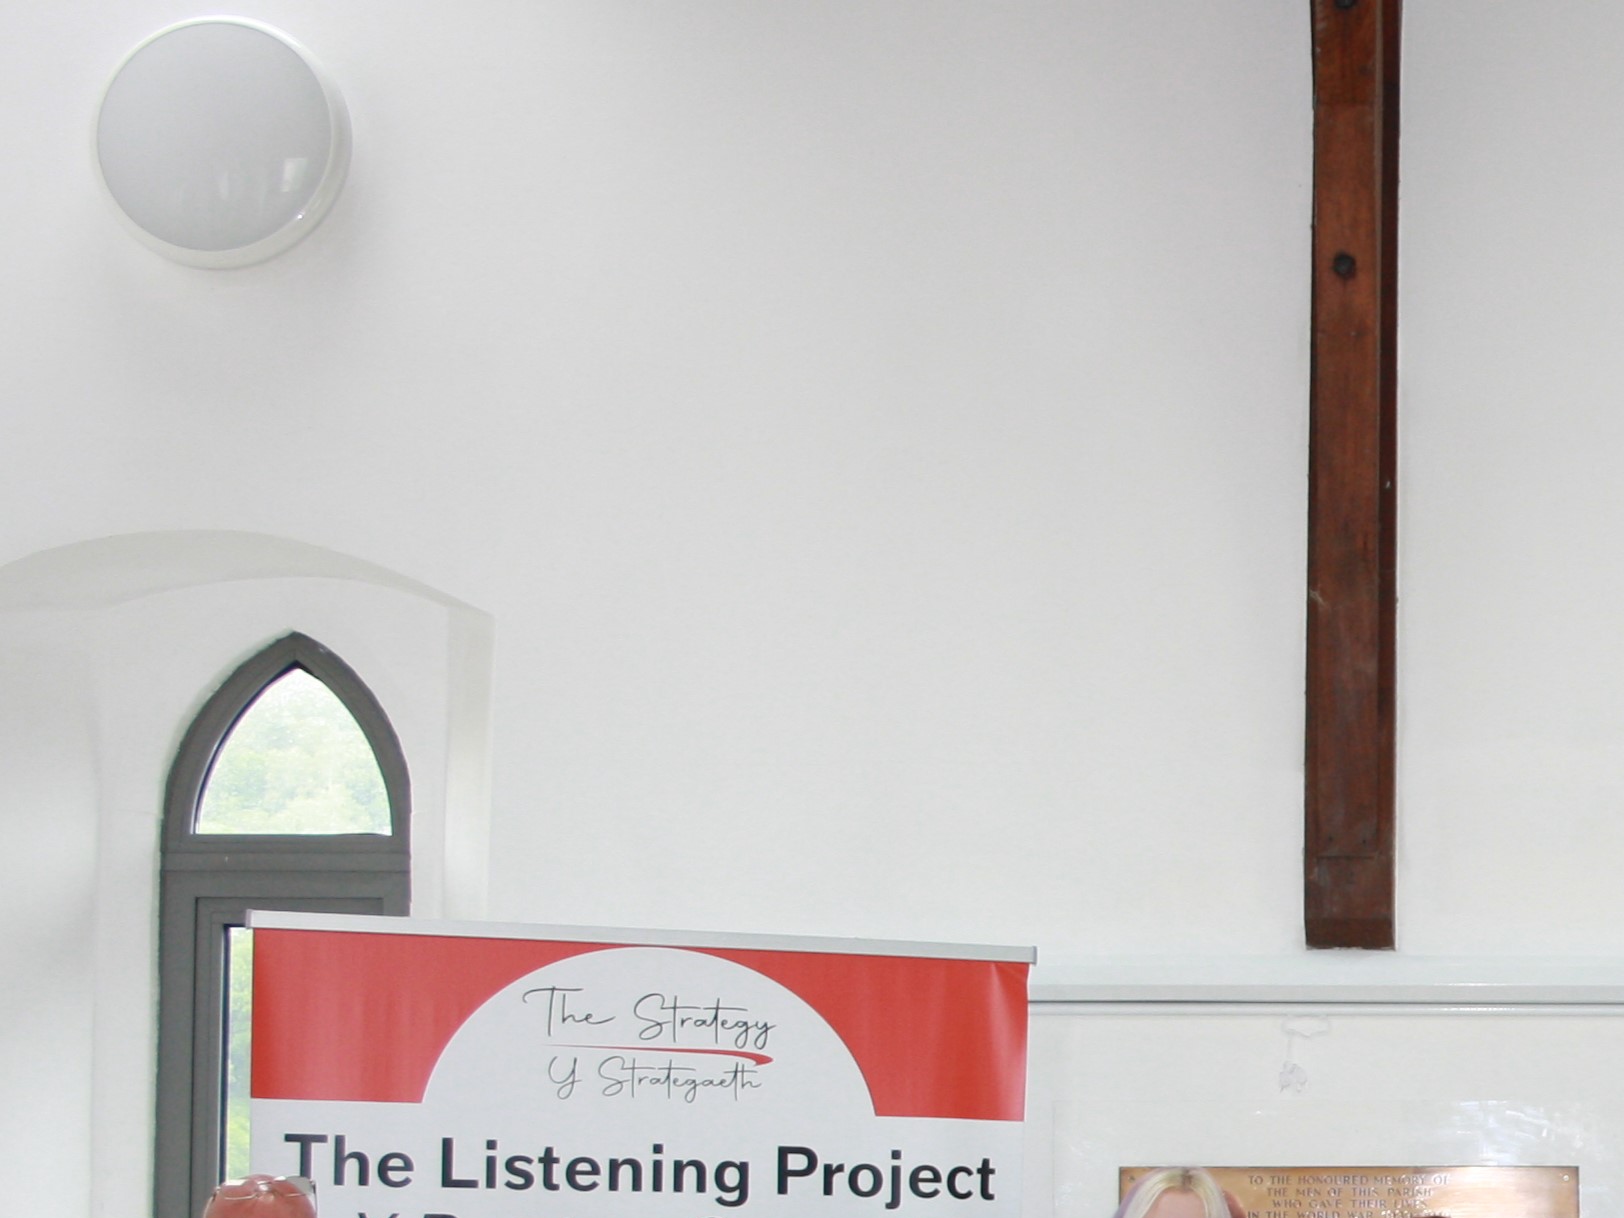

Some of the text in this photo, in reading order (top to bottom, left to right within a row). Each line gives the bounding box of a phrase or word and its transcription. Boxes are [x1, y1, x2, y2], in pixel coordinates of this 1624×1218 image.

[522, 986, 777, 1049] The Strategy
[598, 1056, 761, 1103] Strategaeth
[284, 1133, 995, 1209] The Listening Project
